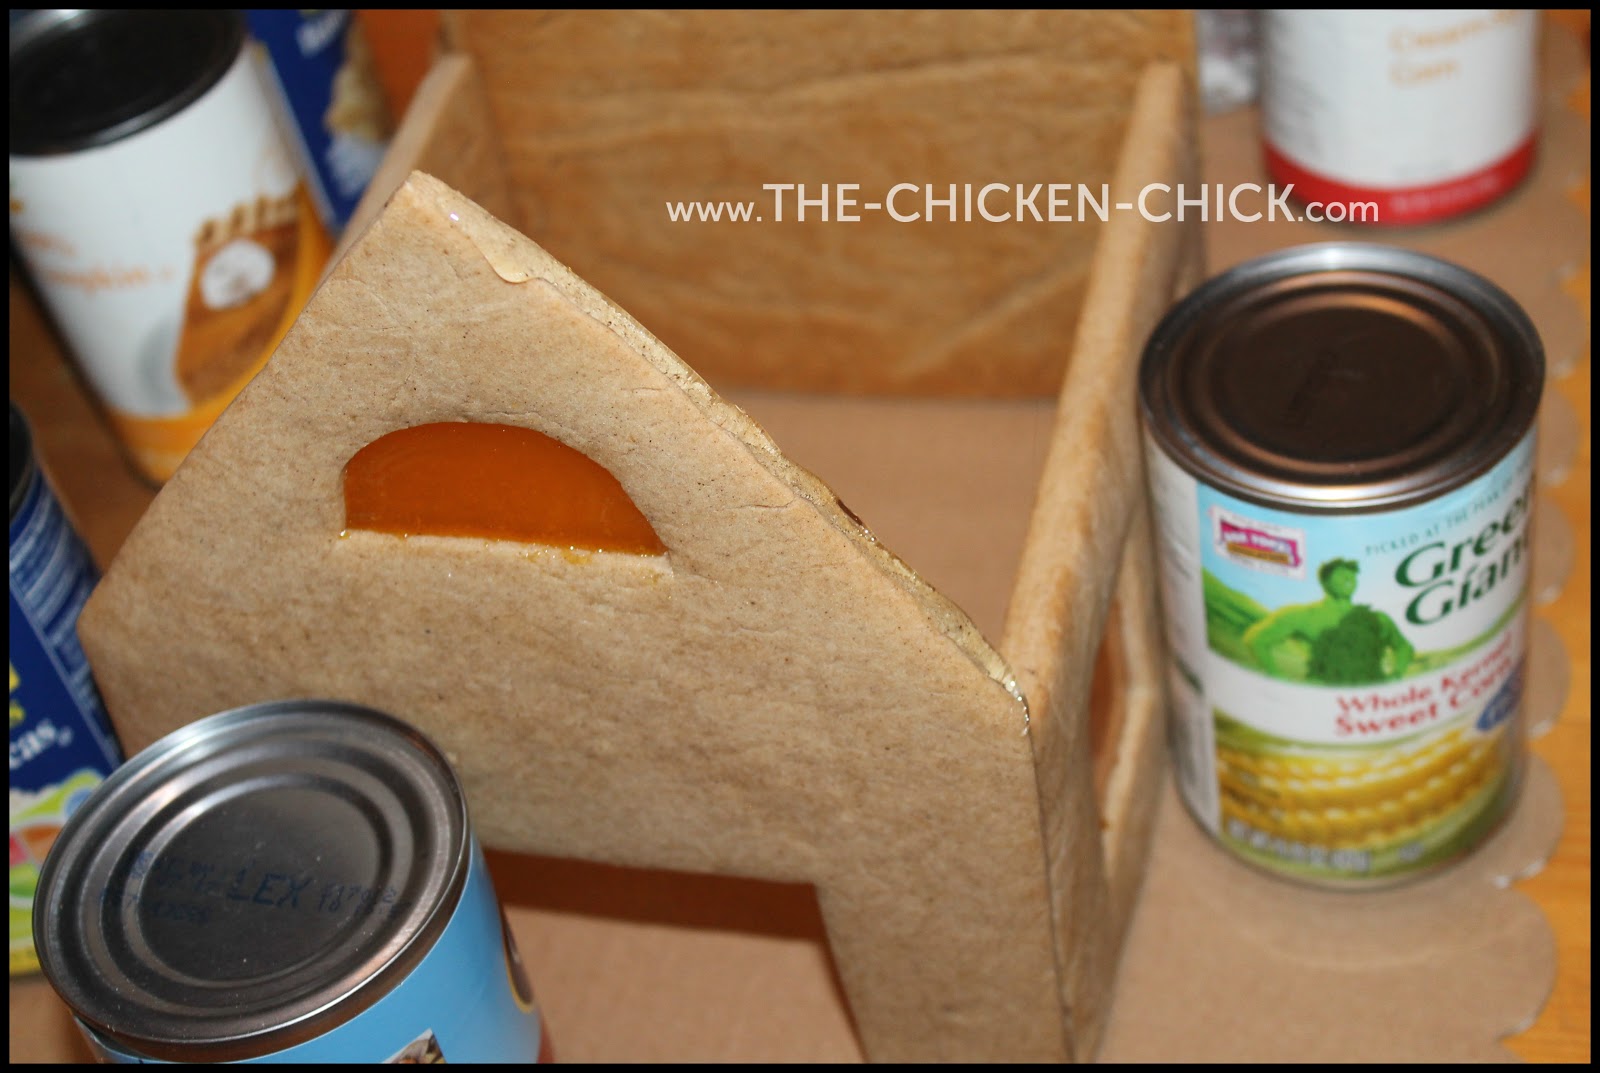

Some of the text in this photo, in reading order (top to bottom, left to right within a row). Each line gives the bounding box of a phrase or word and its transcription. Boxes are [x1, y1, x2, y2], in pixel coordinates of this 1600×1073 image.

[1406, 527, 1530, 626] Gian
[1337, 685, 1433, 714] Whole
[1335, 702, 1438, 737] Sweet
